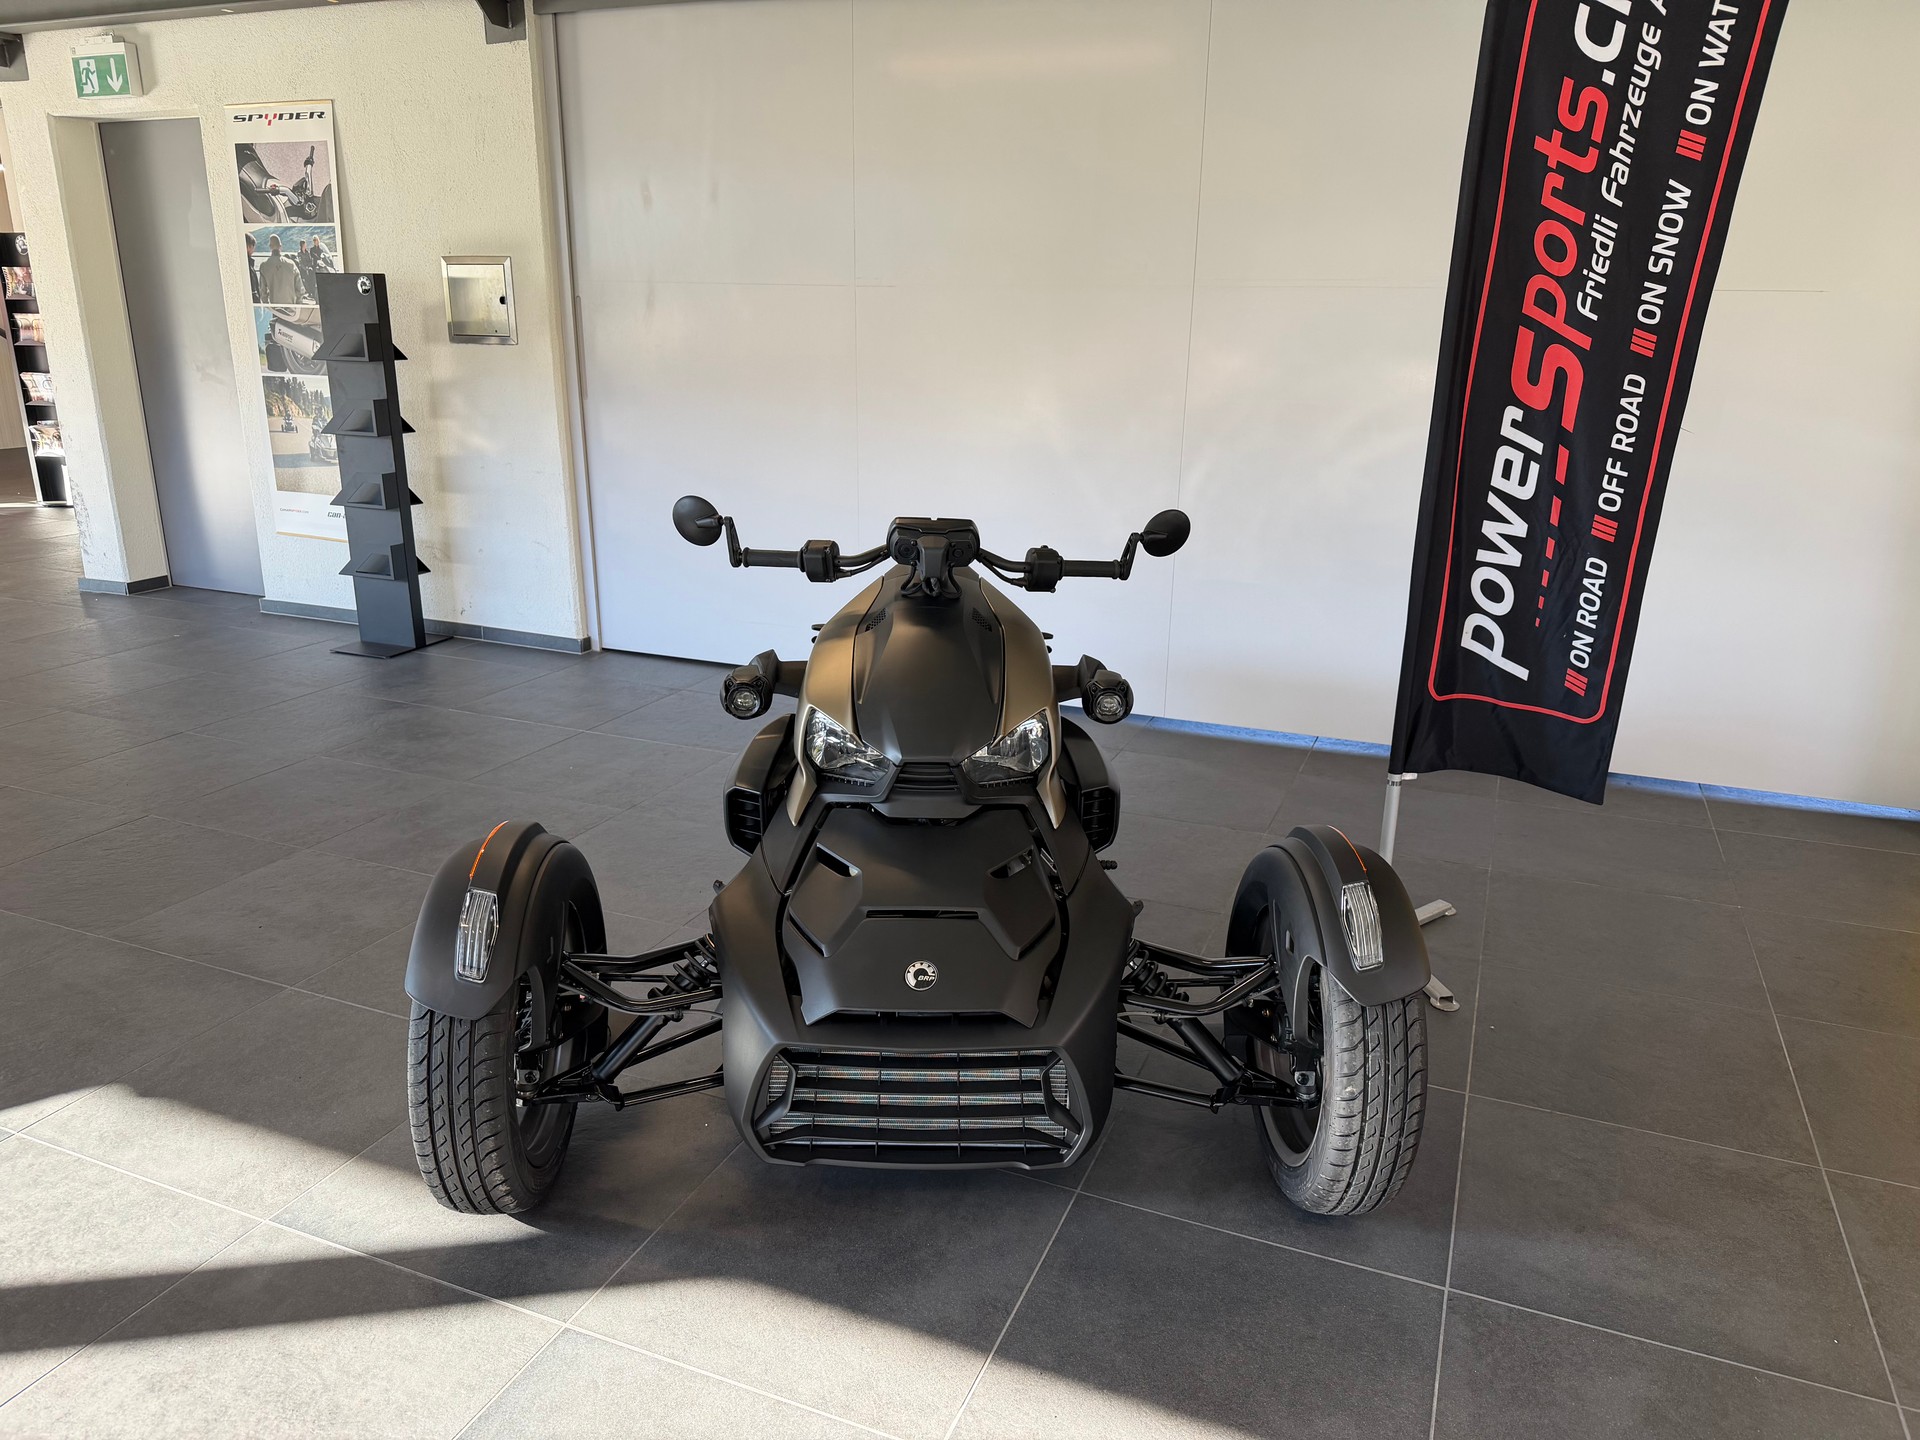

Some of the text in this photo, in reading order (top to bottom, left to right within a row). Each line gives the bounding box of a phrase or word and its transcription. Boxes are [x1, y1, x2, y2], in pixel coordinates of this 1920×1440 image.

[233, 111, 325, 126] SPYDER
[1685, 78, 1720, 126] ON
[1576, 21, 1662, 322] Friedli Fahrzeuge
[1647, 178, 1692, 276] SNOW
[1636, 281, 1668, 325] ON
[1610, 373, 1646, 453] ROAD
[1597, 457, 1629, 512] OFF
[1575, 556, 1608, 630] ROAD
[1569, 630, 1595, 669] ON
